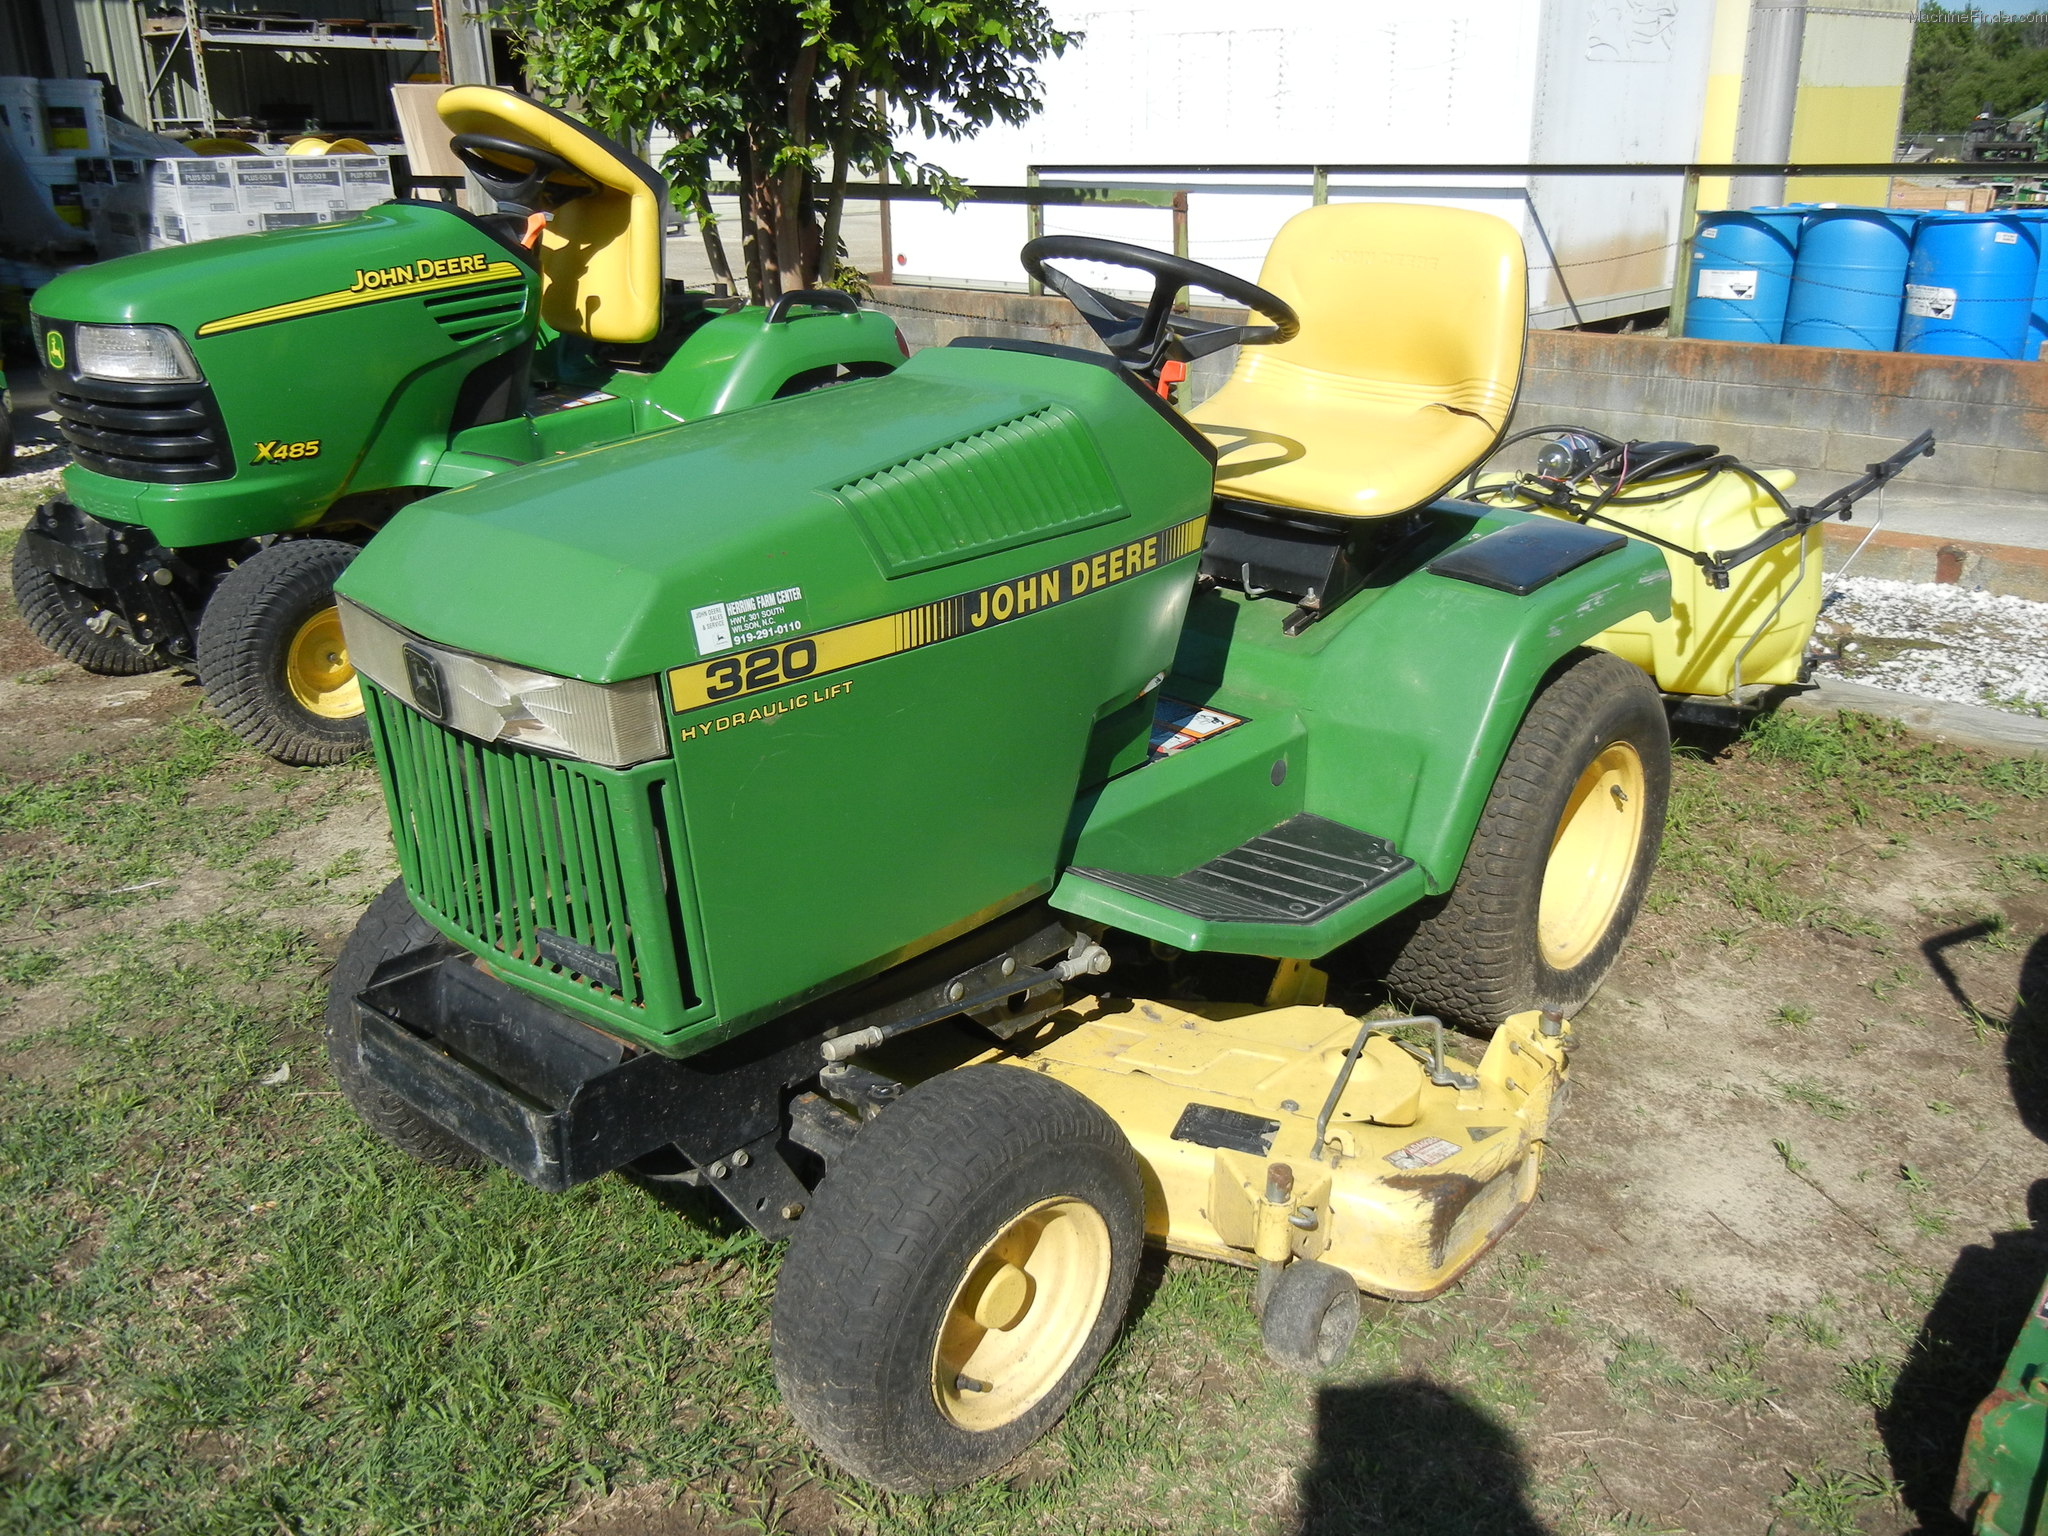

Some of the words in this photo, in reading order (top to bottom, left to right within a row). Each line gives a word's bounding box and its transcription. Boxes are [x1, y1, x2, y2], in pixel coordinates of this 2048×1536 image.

[351, 265, 414, 293] JOHN
[416, 253, 487, 280] DEERE
[251, 440, 320, 464] X485
[970, 569, 1060, 628] JOHN
[1071, 536, 1157, 597] DEERE
[726, 597, 757, 616] HERRING
[756, 592, 777, 609] FARM
[776, 587, 802, 605] CENTER
[730, 616, 748, 626] HWY.
[749, 613, 760, 621] 301
[761, 606, 785, 618] SOUTH
[731, 620, 761, 634] WILSON,
[762, 618, 776, 627] N.C.
[733, 620, 801, 645] 919-291-0110
[706, 639, 817, 700] 320
[681, 694, 809, 742] HYDRAULIC
[813, 680, 854, 704] LIFT
